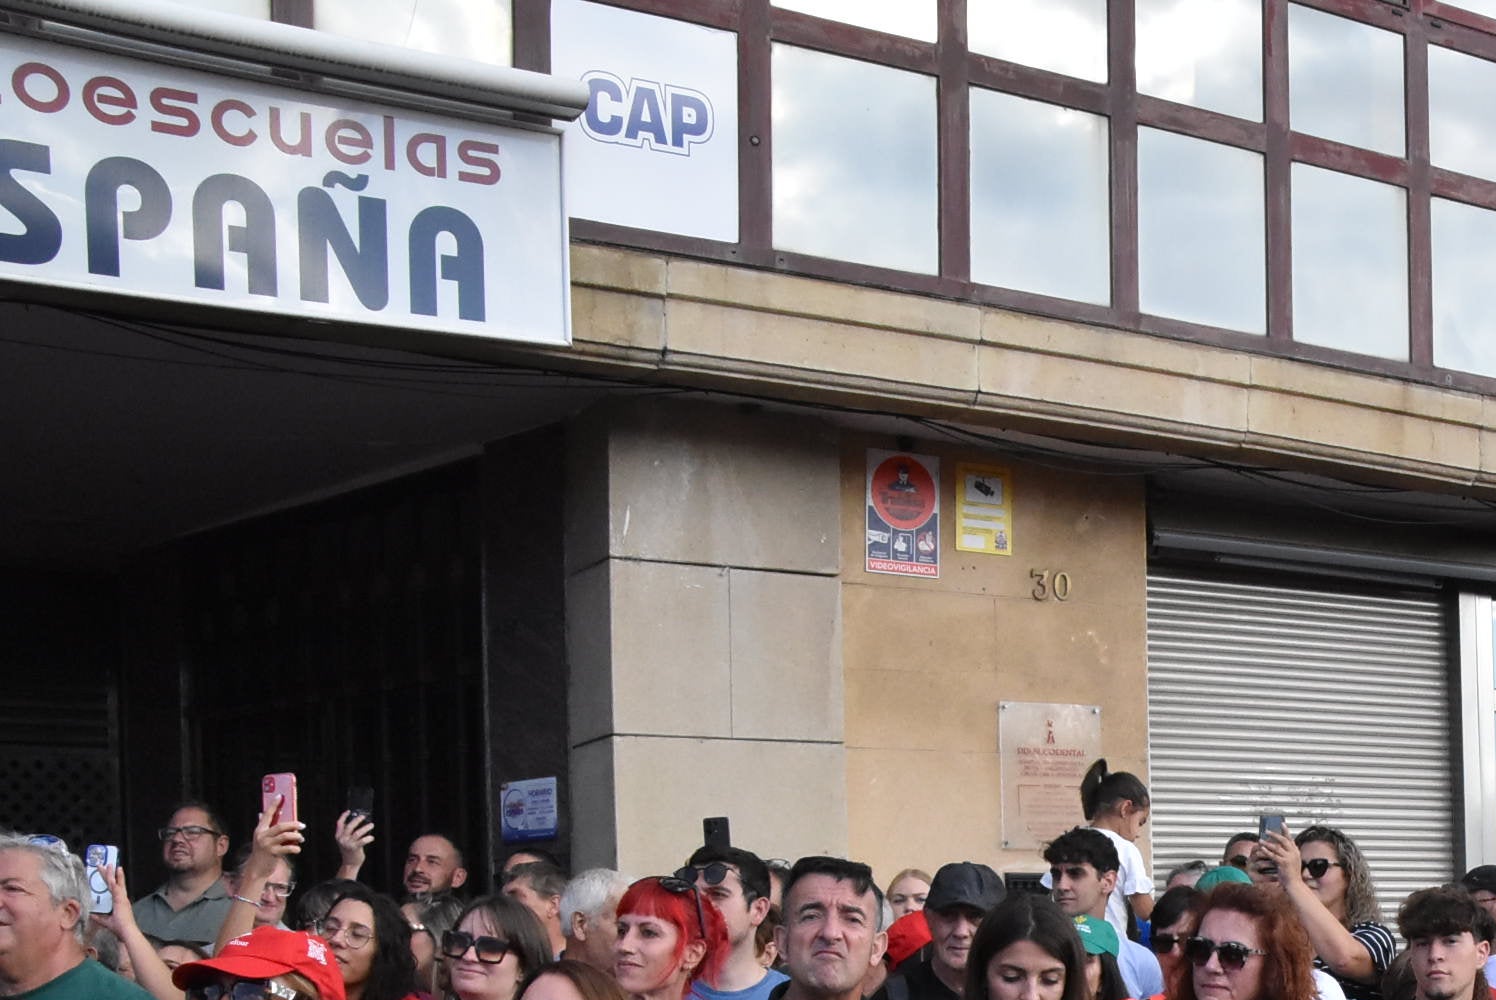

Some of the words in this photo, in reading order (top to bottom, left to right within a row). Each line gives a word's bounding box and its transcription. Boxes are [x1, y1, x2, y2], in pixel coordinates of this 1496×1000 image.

[0, 61, 502, 187] oescuelas
[581, 73, 713, 152] CAP
[869, 560, 936, 575] VIDEOVIGILANCIA
[1028, 567, 1073, 601] 30
